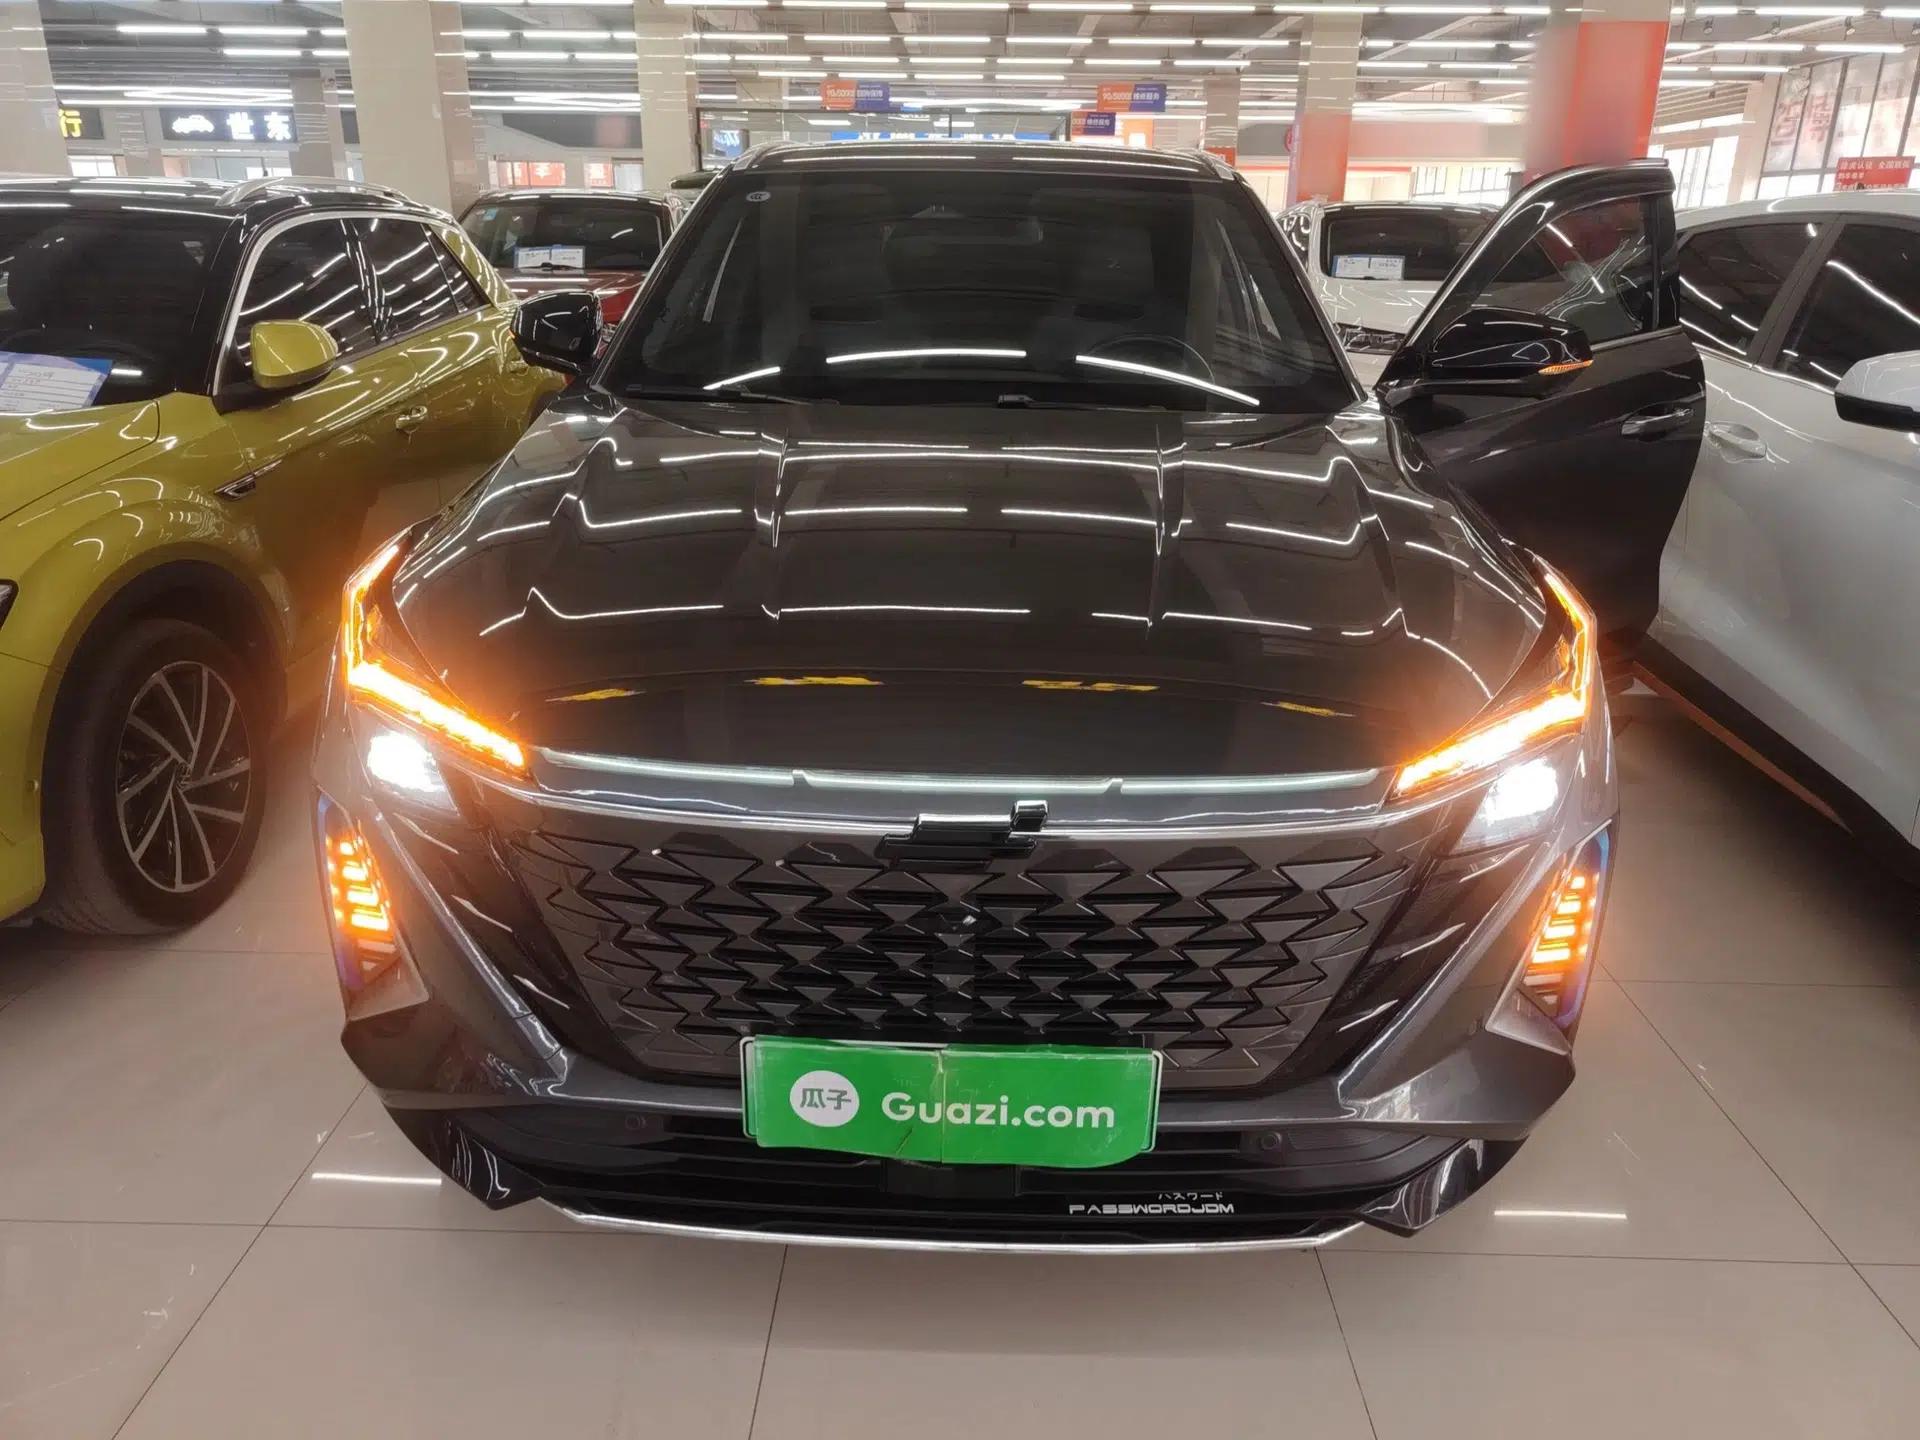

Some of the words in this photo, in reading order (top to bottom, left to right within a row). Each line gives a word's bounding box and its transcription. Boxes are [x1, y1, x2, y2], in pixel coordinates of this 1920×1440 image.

[58, 109, 82, 138] 行
[800, 1087, 852, 1110] 瓜子
[881, 1092, 1115, 1129] Guazi.com
[1069, 1203, 1235, 1214] PASSWORDJDM
